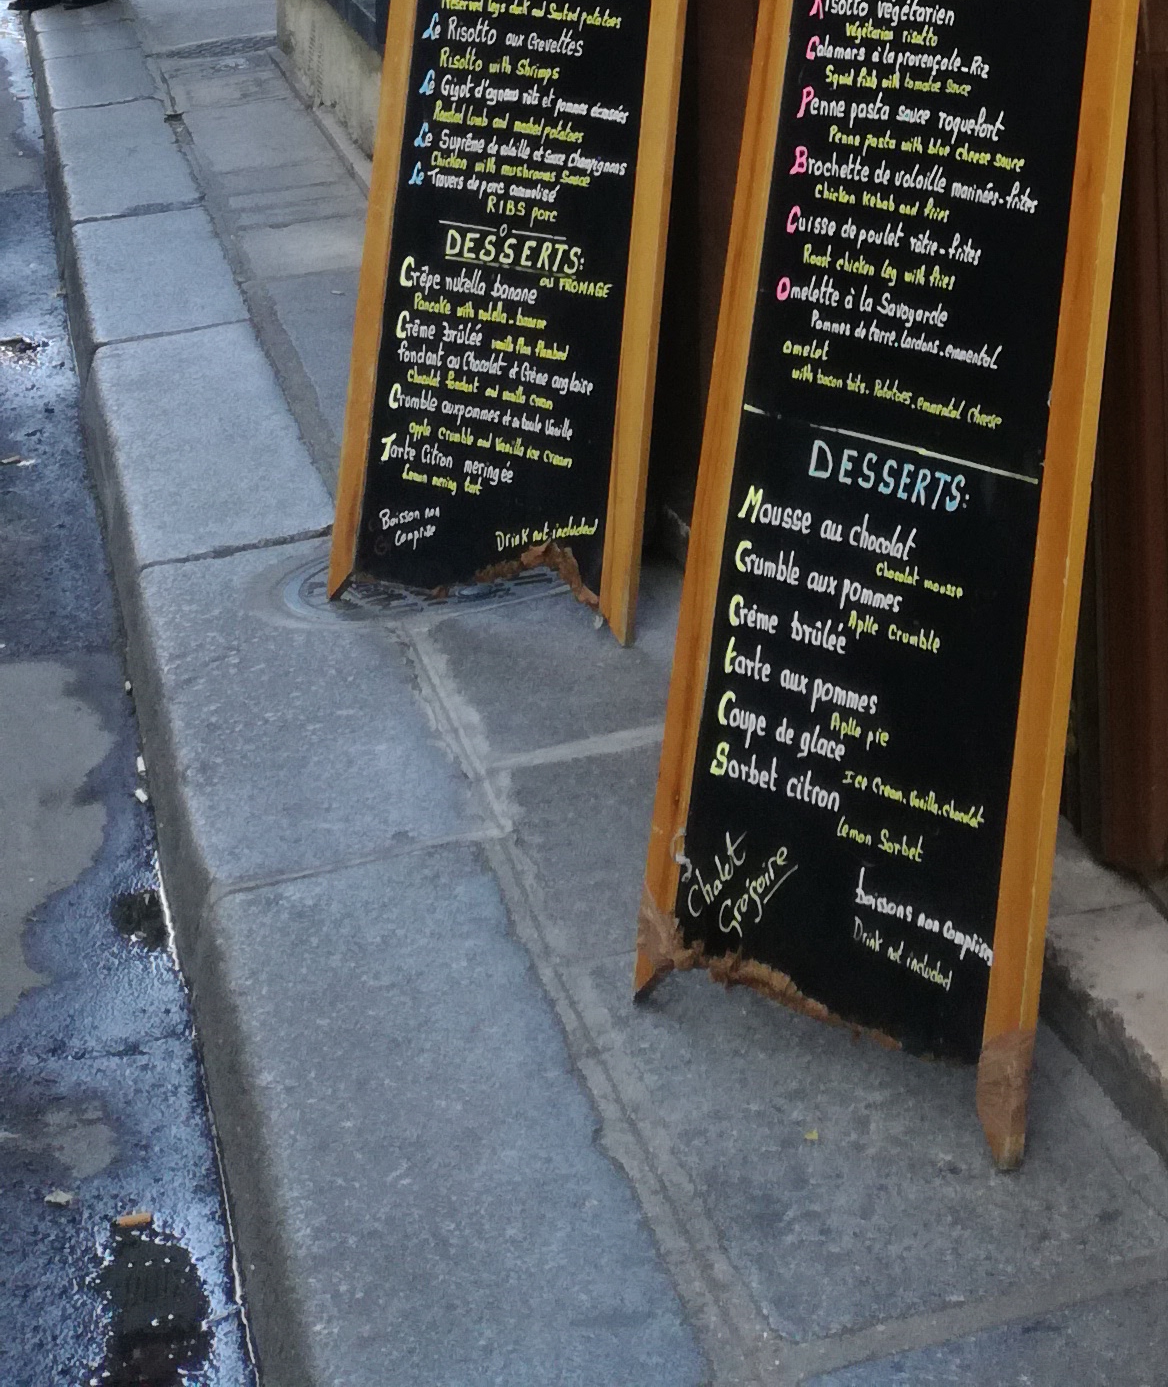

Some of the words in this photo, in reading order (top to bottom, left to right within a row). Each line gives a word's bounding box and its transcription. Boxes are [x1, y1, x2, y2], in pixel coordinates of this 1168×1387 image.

[447, 16, 496, 45] Risotto
[506, 35, 524, 47] aux
[806, 35, 866, 61] Calamars
[439, 47, 482, 72] Risotto
[441, 75, 474, 99] Gigot
[797, 86, 845, 118] Penne
[850, 92, 890, 128] pasta
[896, 104, 931, 126] sauce
[938, 106, 1005, 144] roquefort
[829, 125, 861, 147] Penne
[863, 130, 896, 157] pasta
[901, 134, 923, 154] with
[789, 145, 870, 183] Brochette
[874, 160, 890, 185] de
[895, 164, 947, 193] volaille
[487, 195, 525, 216] RIBS
[786, 205, 837, 237] Cuisse
[400, 256, 440, 295] Crêpe
[446, 269, 486, 297] nutella
[559, 278, 614, 299] FROMAGE
[776, 274, 840, 308] Omelette
[844, 287, 856, 310] à
[860, 284, 873, 314] la
[877, 293, 949, 328] Savoyarde
[737, 484, 812, 535] Mousse
[820, 519, 843, 542] au
[735, 540, 800, 586] Crumble
[807, 571, 836, 596] aux
[839, 578, 903, 613] pommes
[780, 668, 809, 696] aux
[811, 677, 878, 715] pommes
[717, 690, 767, 749] Coupe
[775, 717, 795, 746] de
[797, 724, 847, 762] glace
[710, 741, 779, 792] Sorbet
[787, 770, 841, 813] citron
[878, 829, 924, 863] Sorbet
